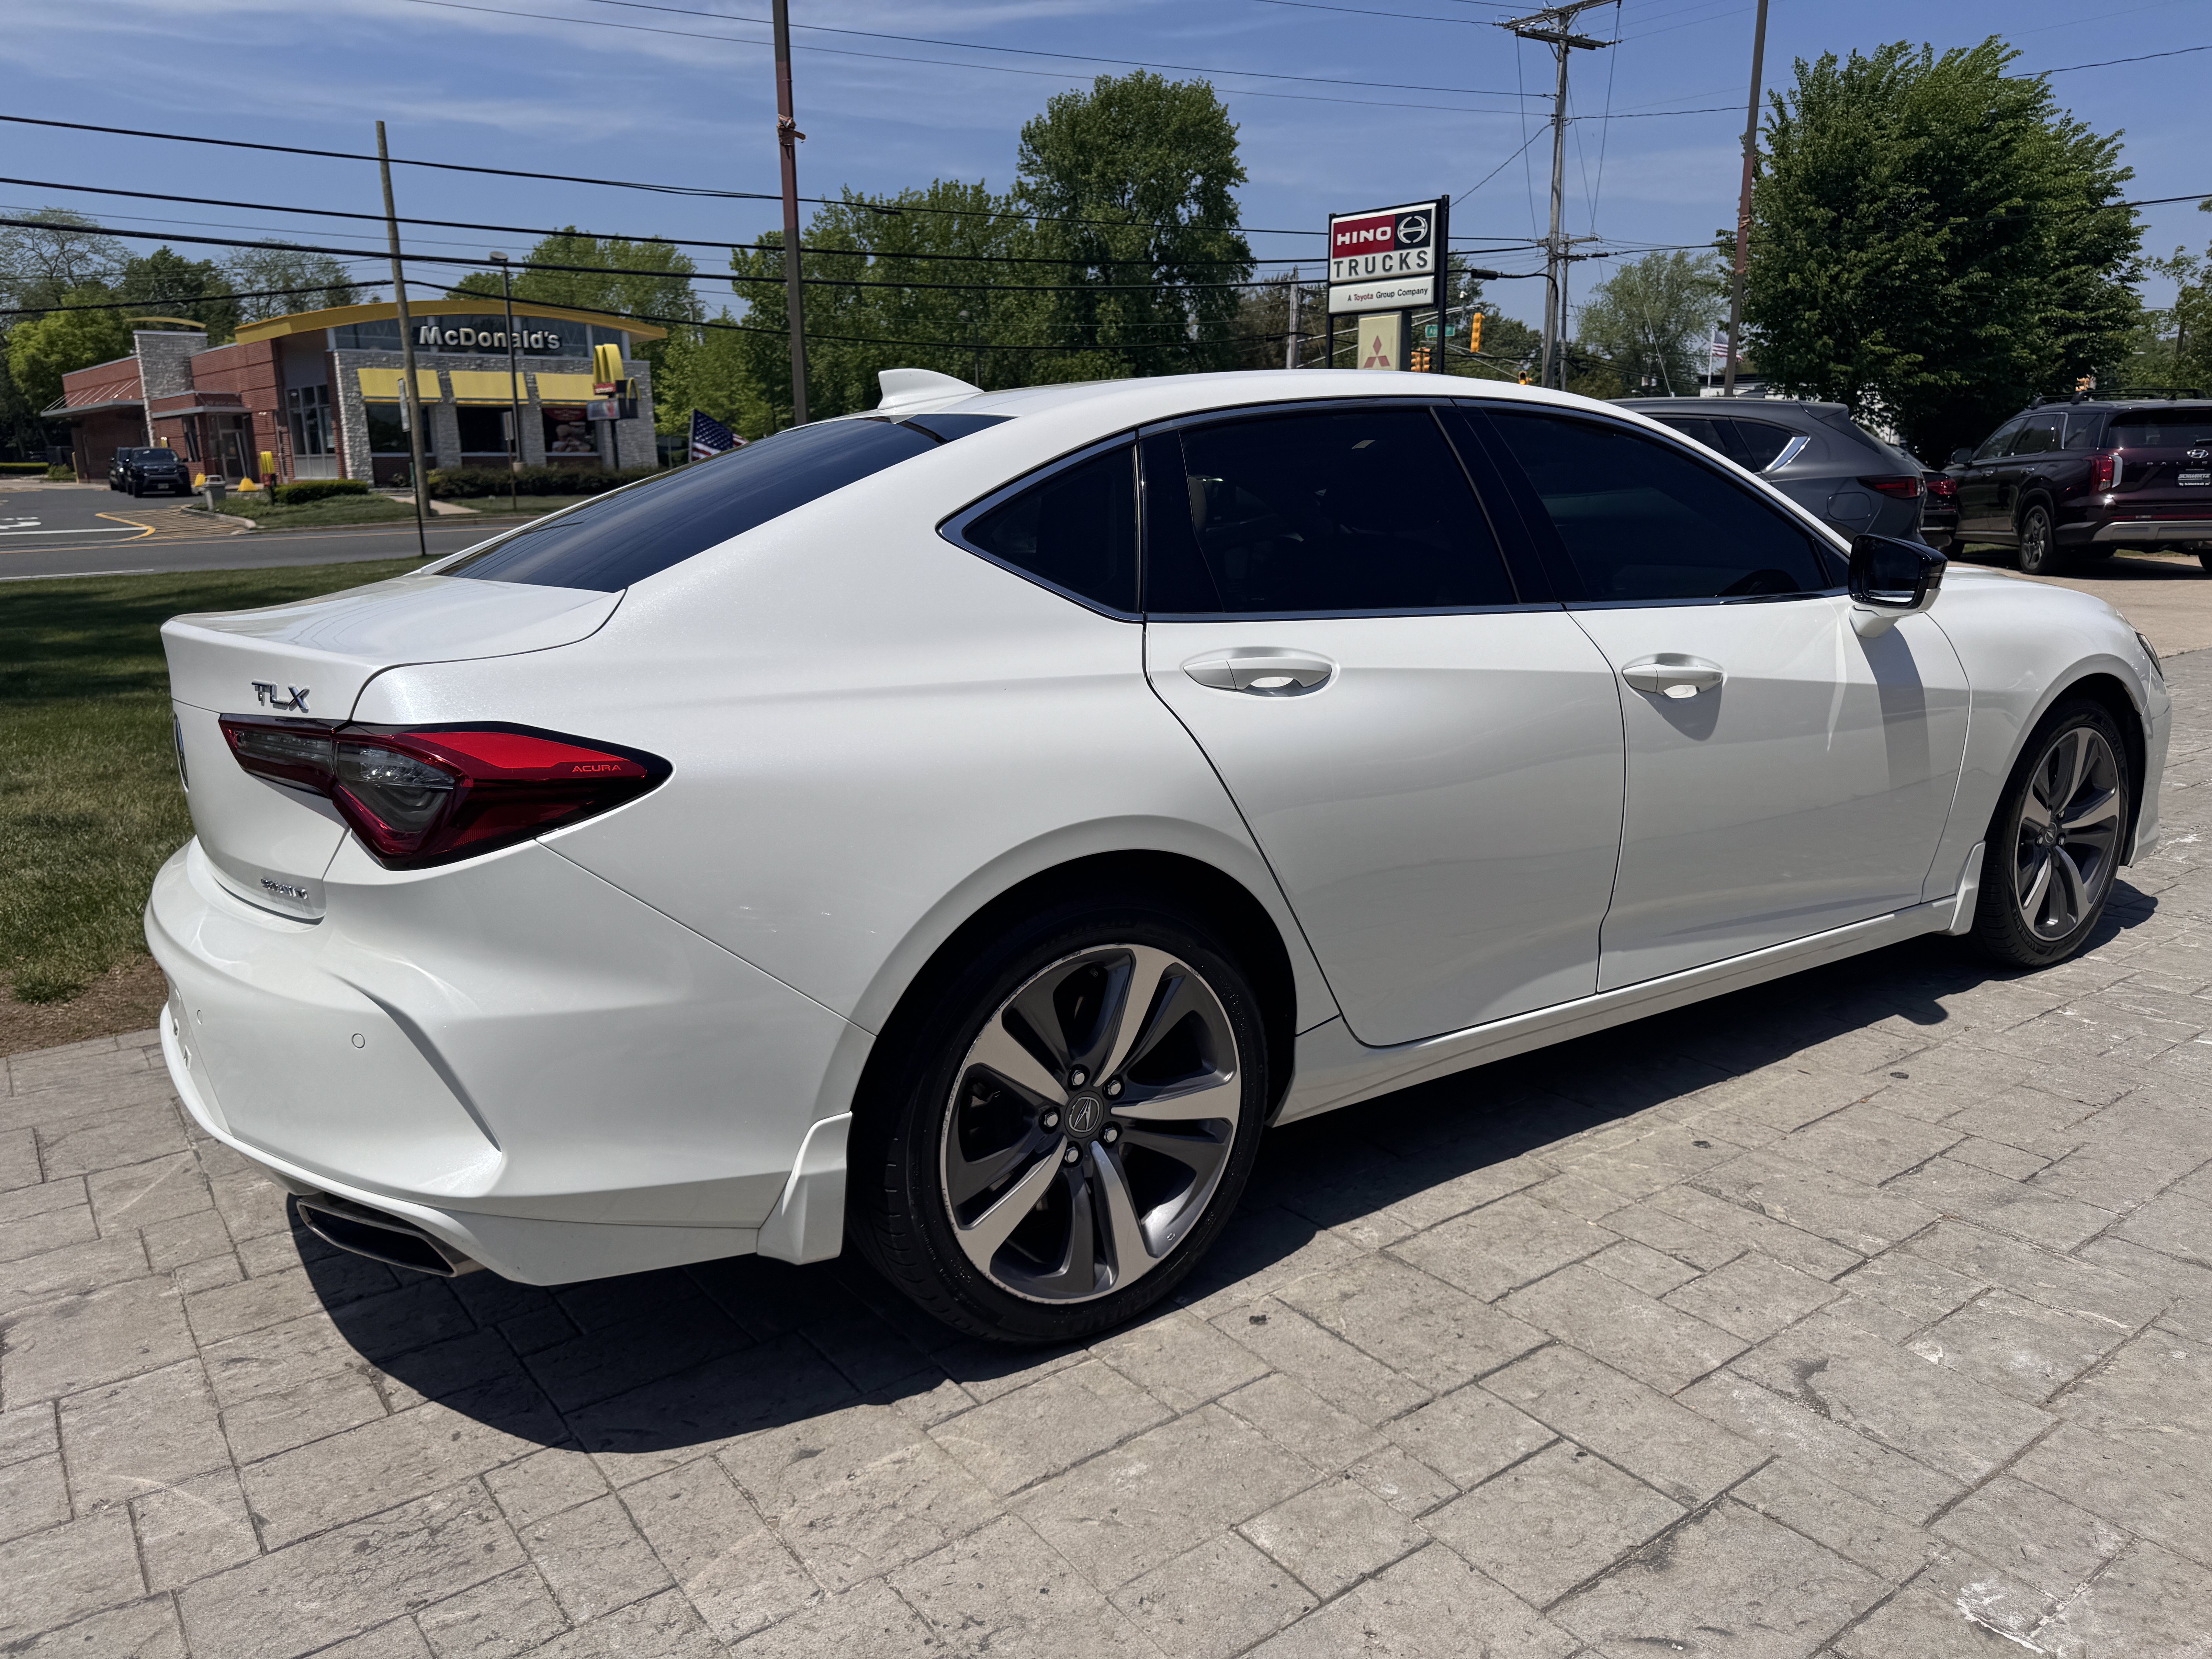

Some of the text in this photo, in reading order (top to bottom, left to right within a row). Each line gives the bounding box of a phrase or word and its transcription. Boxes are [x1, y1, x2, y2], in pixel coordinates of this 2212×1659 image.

[1337, 227, 1391, 246] HINO
[1333, 250, 1428, 278] TRUCKS
[1353, 293, 1374, 302] Toyota
[1397, 288, 1428, 297] Company
[419, 326, 560, 349] McDonald's
[251, 679, 310, 710] TLX
[572, 764, 622, 773] ACURA
